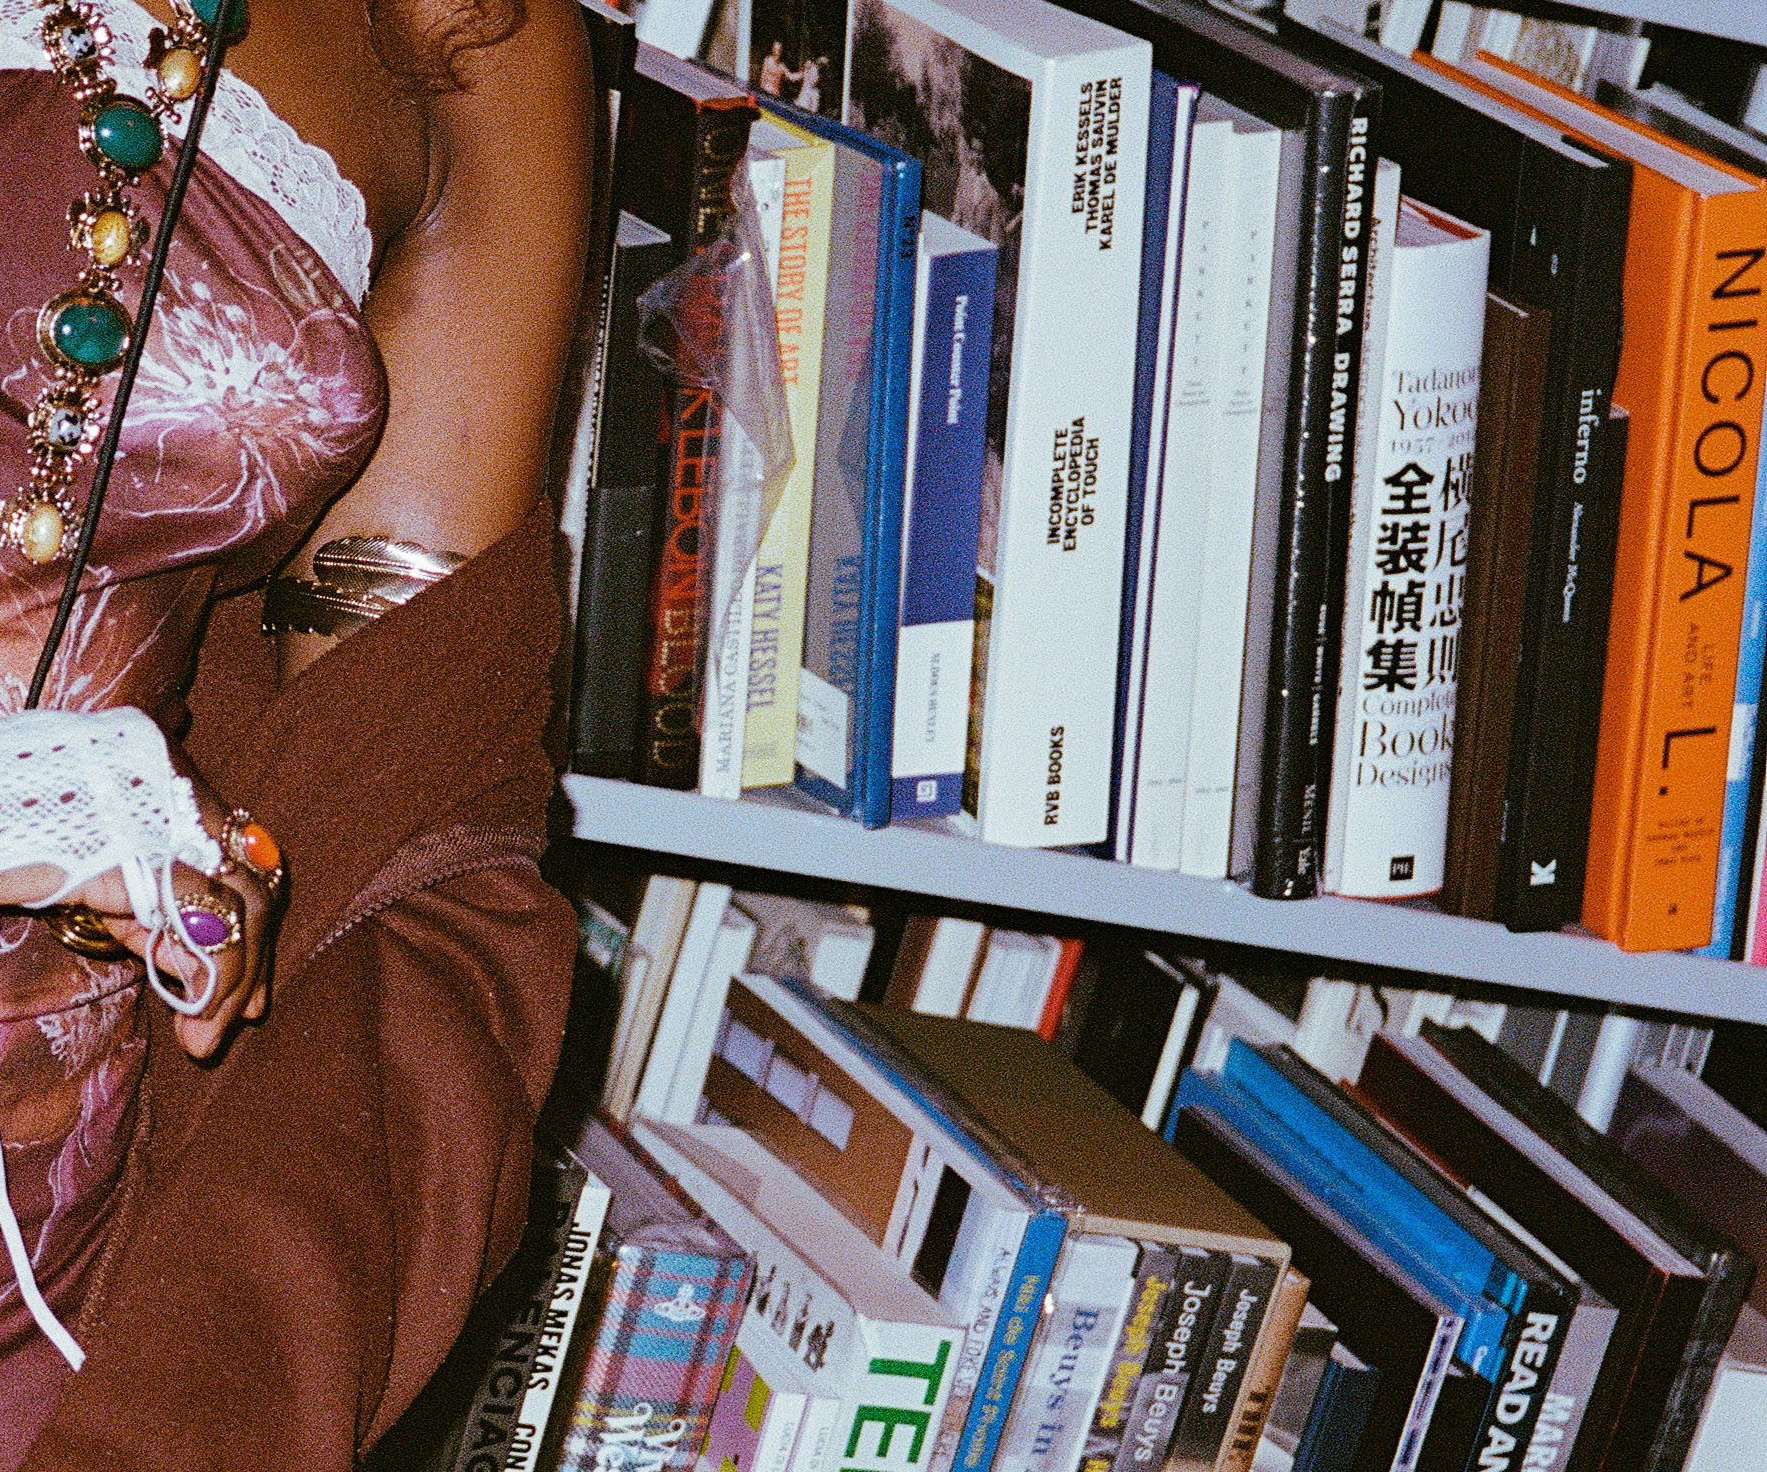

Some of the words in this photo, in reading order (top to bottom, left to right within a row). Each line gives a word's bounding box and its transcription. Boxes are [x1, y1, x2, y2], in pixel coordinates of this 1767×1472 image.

[1075, 81, 1101, 167] KESSELS
[1086, 78, 1114, 149] SAUVIN
[1098, 77, 1122, 156] MULDER
[781, 177, 812, 223] THE
[1071, 172, 1086, 214] ERIK
[1081, 153, 1108, 232] THOMAS
[1103, 162, 1117, 185] DE
[1344, 117, 1368, 239] RICHARD
[1099, 191, 1116, 250] KAREL
[775, 225, 809, 301] STORY
[1336, 246, 1359, 335] SERRA
[774, 304, 804, 336] OF
[780, 340, 802, 386] ART
[1324, 352, 1350, 482] DRAWING
[1572, 388, 1602, 485] inferno
[1679, 247, 1766, 602] NICOLA
[1047, 428, 1080, 545] INCOMPLETE
[1051, 416, 1097, 552] ENCYCLOPEDIA
[1075, 437, 1099, 500] TOUCH
[1080, 505, 1095, 526] OF
[752, 564, 784, 621] KATY
[745, 627, 780, 714] HESSEL
[1698, 643, 1715, 686] LIFE
[1046, 725, 1065, 786] BOOKS
[1658, 726, 1717, 797] L.
[1044, 790, 1061, 826] RVB
[547, 1218, 591, 1302] JONAS
[522, 1304, 569, 1392] MEKAS
[1123, 1275, 1166, 1356] Joseph
[1158, 1280, 1212, 1380] Joseph
[1222, 1289, 1258, 1353] Joseph
[1046, 1306, 1101, 1416] Beuys
[1100, 1360, 1139, 1427] Beuys
[1202, 1358, 1236, 1413] Beuys
[1496, 1312, 1558, 1425] READ
[1032, 1423, 1064, 1455] in
[1133, 1383, 1179, 1462] Beuys
